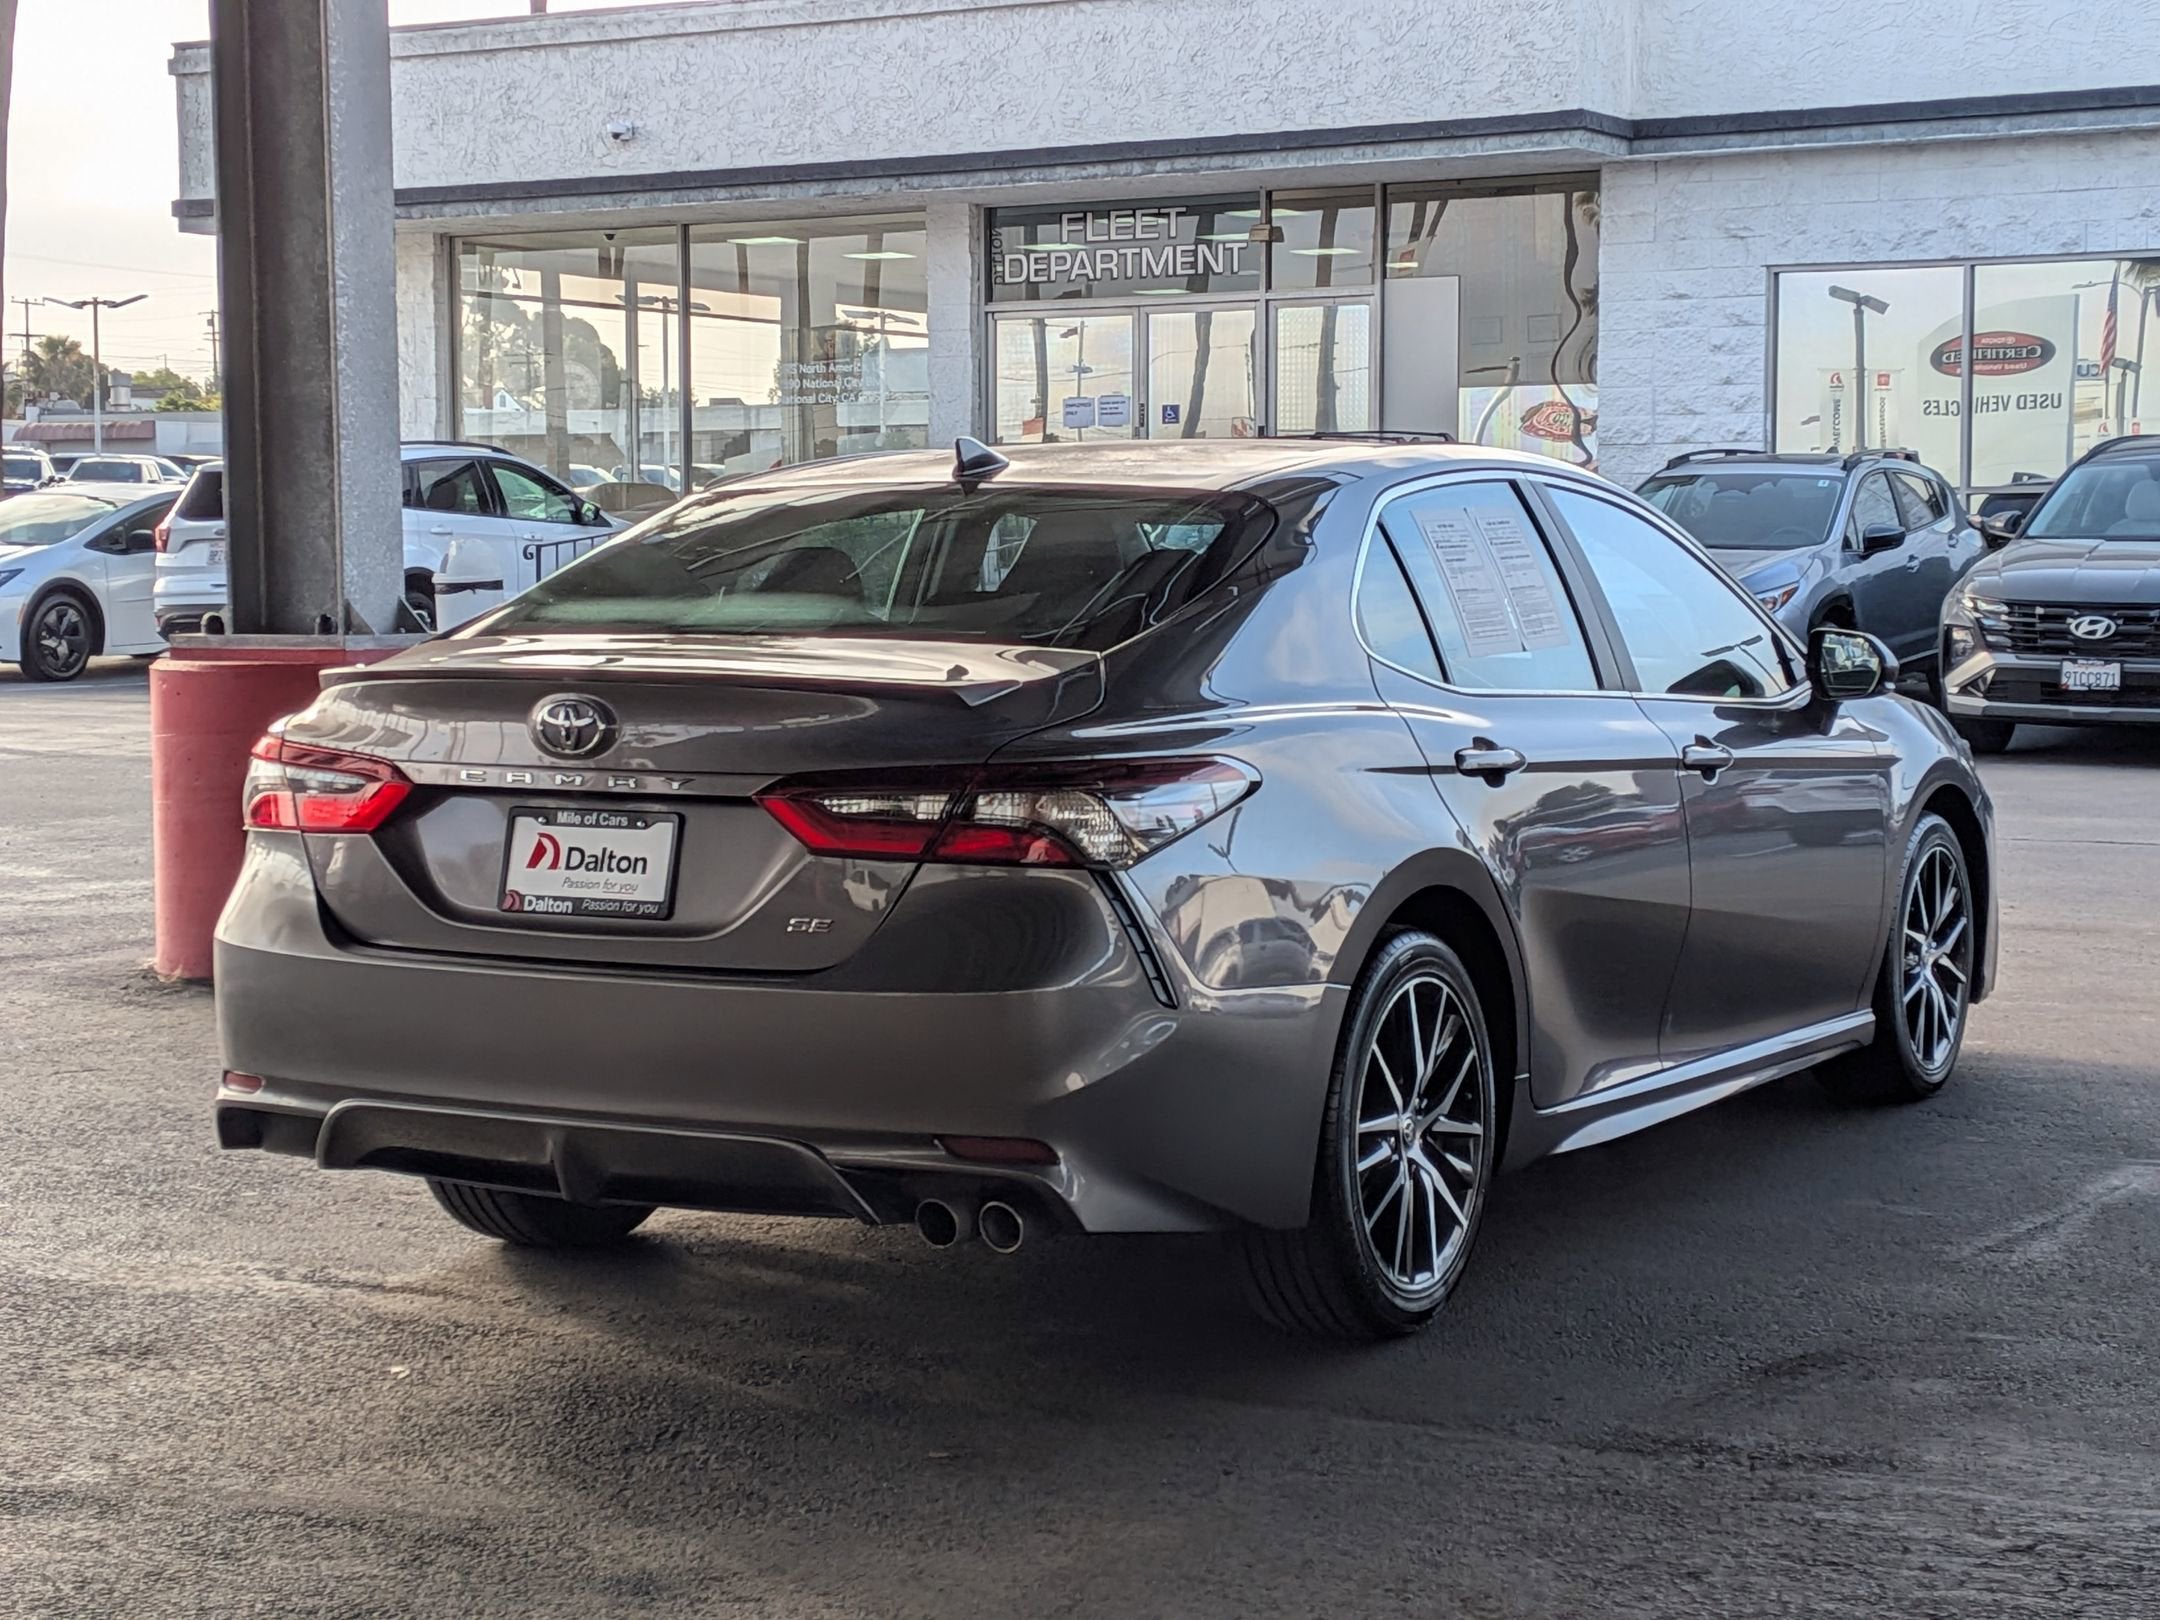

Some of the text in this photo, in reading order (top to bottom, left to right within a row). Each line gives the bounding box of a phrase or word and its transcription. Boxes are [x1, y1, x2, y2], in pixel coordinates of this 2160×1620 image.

[1060, 206, 1187, 243] FLEET
[1003, 241, 1248, 284] DEPARTMENT
[779, 392, 815, 404] ational
[460, 769, 696, 791] CAMRY
[556, 811, 628, 826] Mile of Cars
[564, 846, 648, 875] Dalton
[562, 876, 639, 893] Passion for you
[523, 895, 659, 915] Dalton Passion for you
[787, 918, 832, 933] SE
